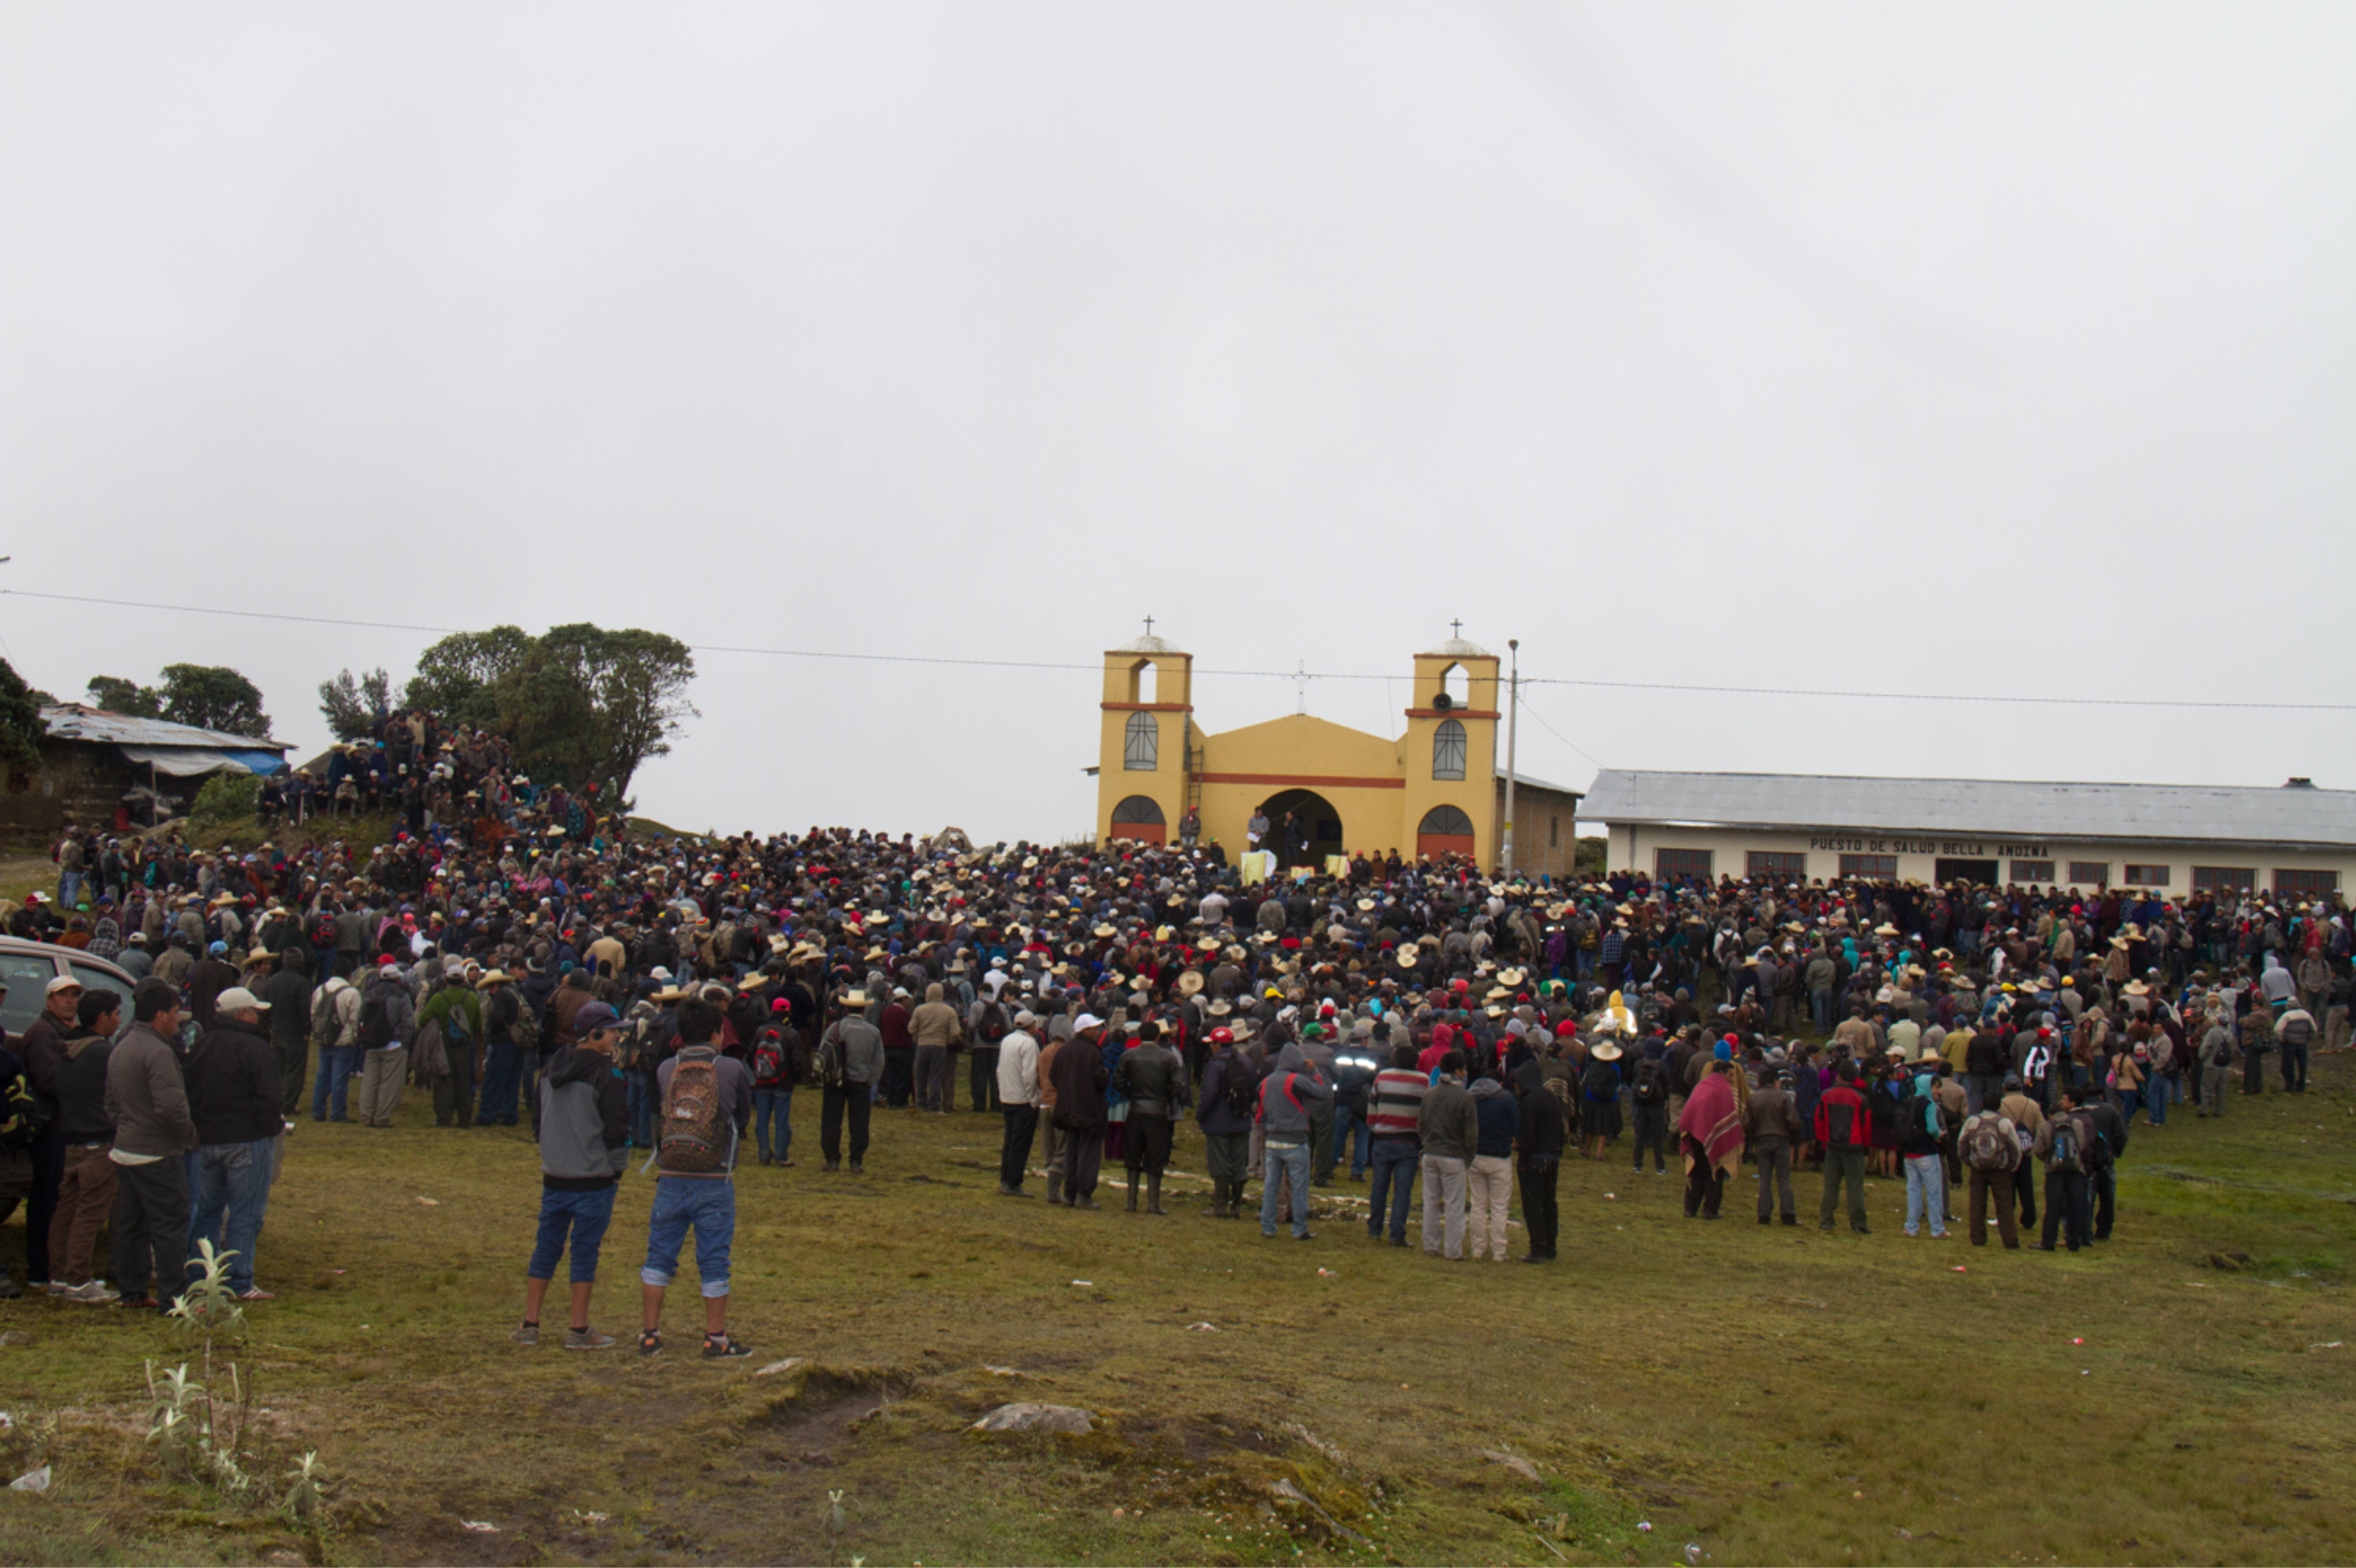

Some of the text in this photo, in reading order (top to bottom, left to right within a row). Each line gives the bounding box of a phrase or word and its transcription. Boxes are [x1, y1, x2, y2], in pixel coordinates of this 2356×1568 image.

[1811, 838, 2048, 857] PUESTO DE SALUD BELLA ANDINA
